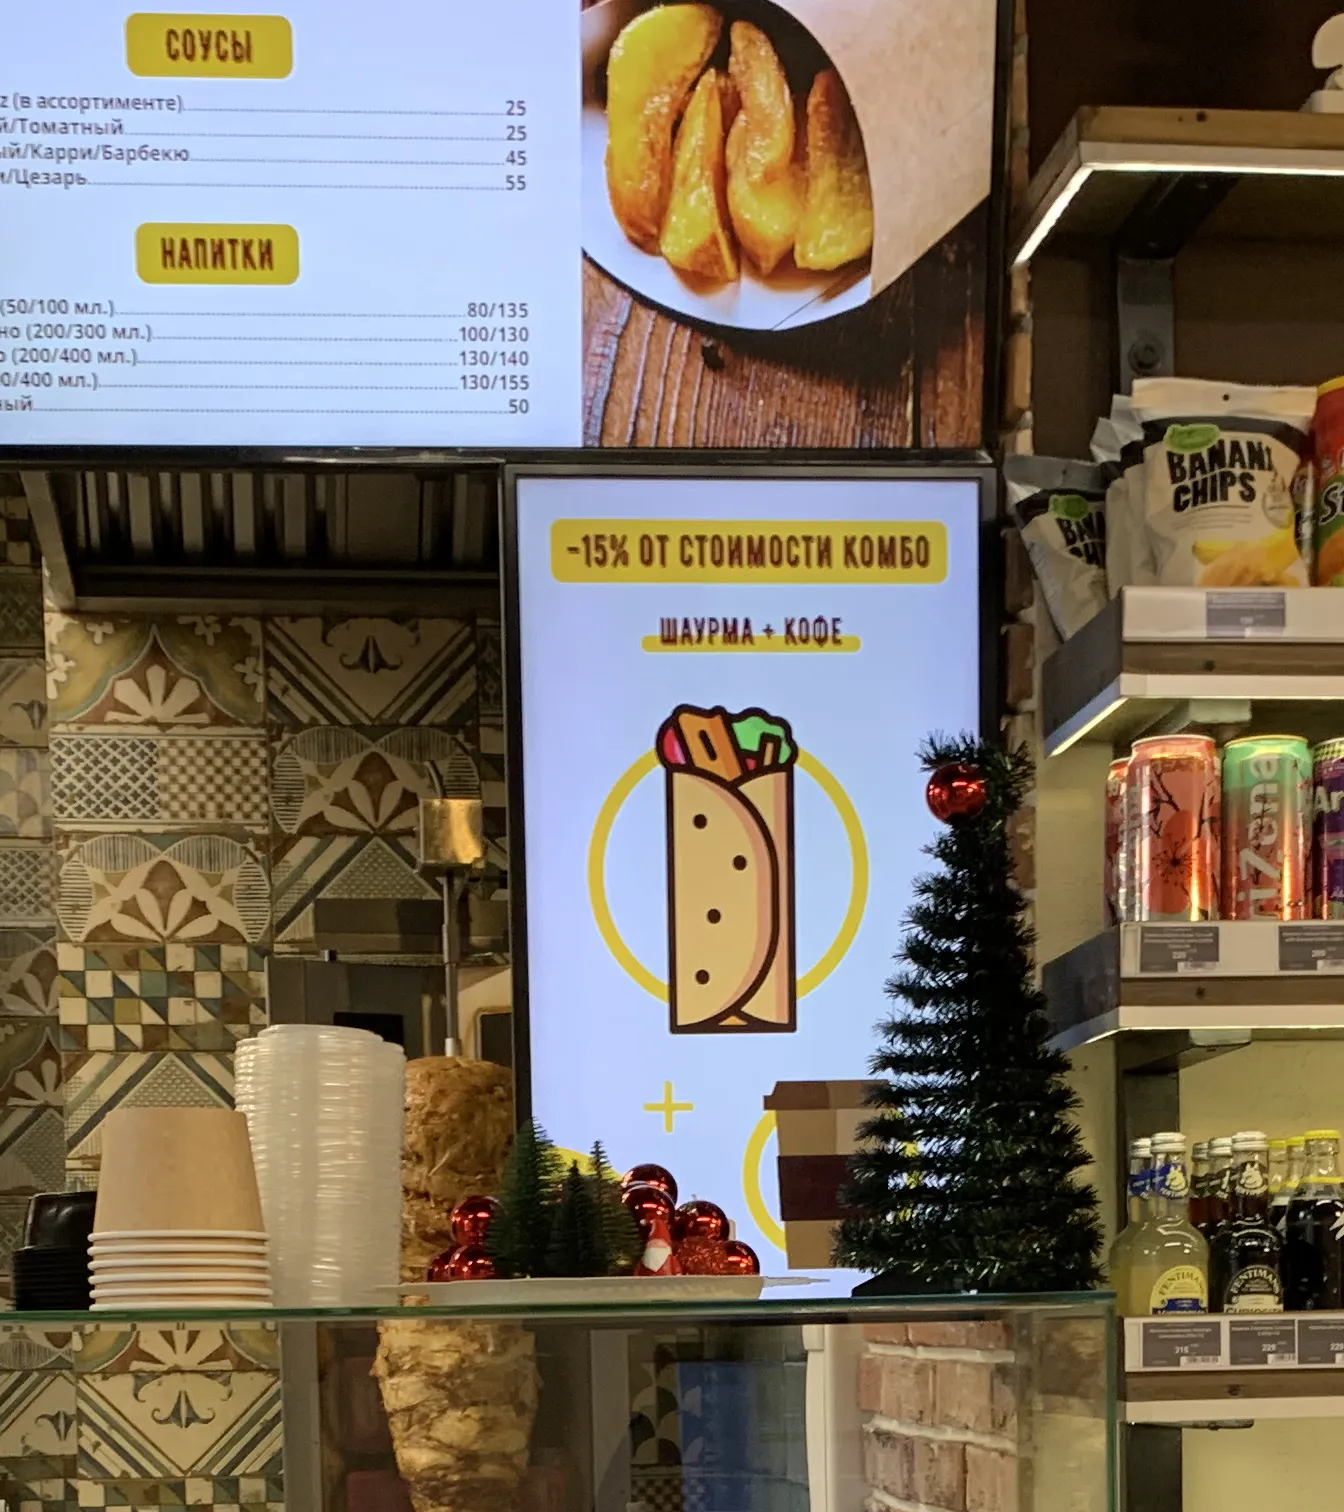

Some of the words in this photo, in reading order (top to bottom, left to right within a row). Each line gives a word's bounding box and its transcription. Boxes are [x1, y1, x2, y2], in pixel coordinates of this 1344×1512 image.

[164, 28, 253, 64] СОУСЫ
[13, 91, 33, 113] (в
[37, 93, 184, 114] ассортименте)
[505, 100, 527, 117] 25
[505, 126, 527, 142] 25
[505, 151, 527, 167] 45
[504, 175, 527, 191] 55
[159, 237, 276, 272] НАПИТКИ
[0, 297, 70, 318] (50/100
[73, 297, 115, 318] мл.)
[466, 303, 529, 321] 80/135
[26, 321, 107, 343] (200/300
[111, 321, 153, 343] мл.)
[458, 327, 529, 344] 100/130
[11, 345, 93, 367] (200/400
[97, 346, 138, 368] мл.)
[458, 351, 529, 367] 130/140
[57, 370, 99, 391] мл.)
[458, 374, 529, 391] 130/155
[508, 398, 529, 414] 50
[1172, 471, 1258, 514] CHIPS
[566, 534, 629, 569] -15%
[639, 534, 672, 568] ОТ
[679, 535, 833, 569] СТОИМОСТИ
[843, 535, 931, 569] КОМБО
[660, 618, 755, 646] ШАУРМА
[784, 616, 843, 646] КОФЕ
